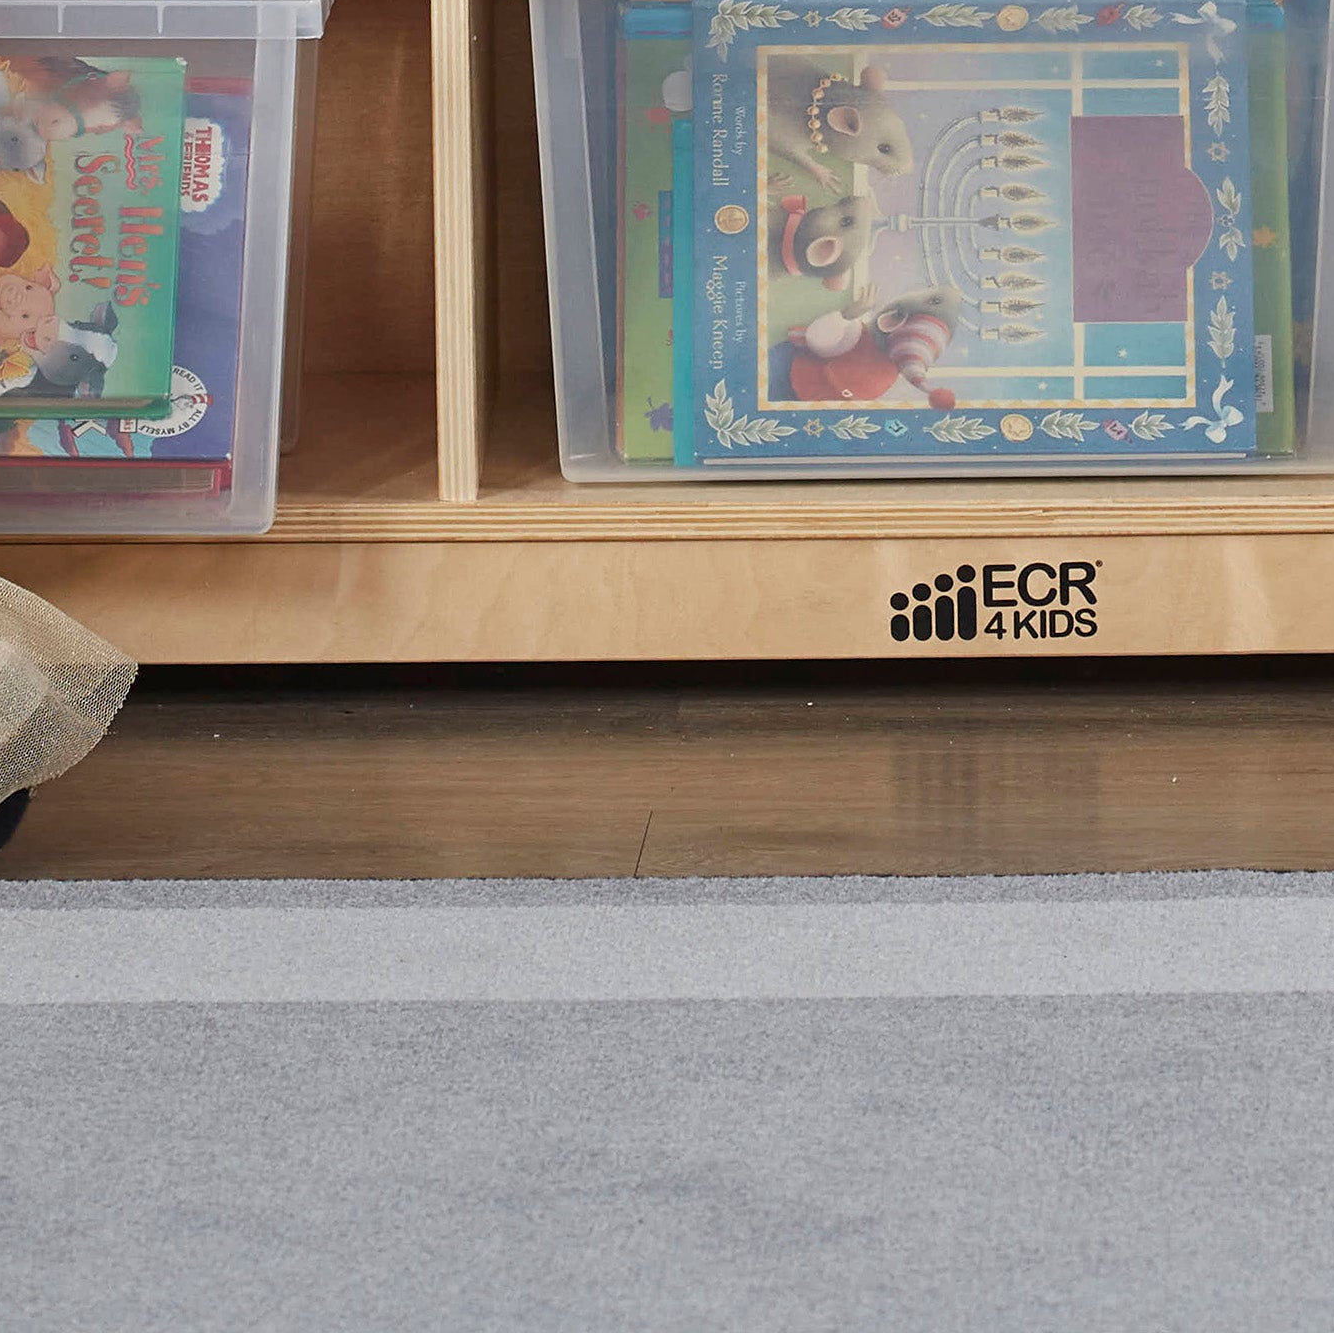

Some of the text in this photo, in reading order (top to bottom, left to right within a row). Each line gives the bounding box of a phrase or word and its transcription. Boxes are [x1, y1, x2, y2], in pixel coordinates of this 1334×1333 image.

[191, 125, 212, 203] THOMAS
[711, 129, 730, 186] Randall
[730, 105, 748, 156] Words by
[69, 152, 121, 290] Secret!
[114, 134, 166, 307] Mrs. Hen's
[706, 255, 729, 370] Maggie Kneen
[732, 281, 748, 344] Pictures by
[138, 367, 204, 435] READ IT ALL BY MYSELF
[982, 562, 1098, 608] ECR
